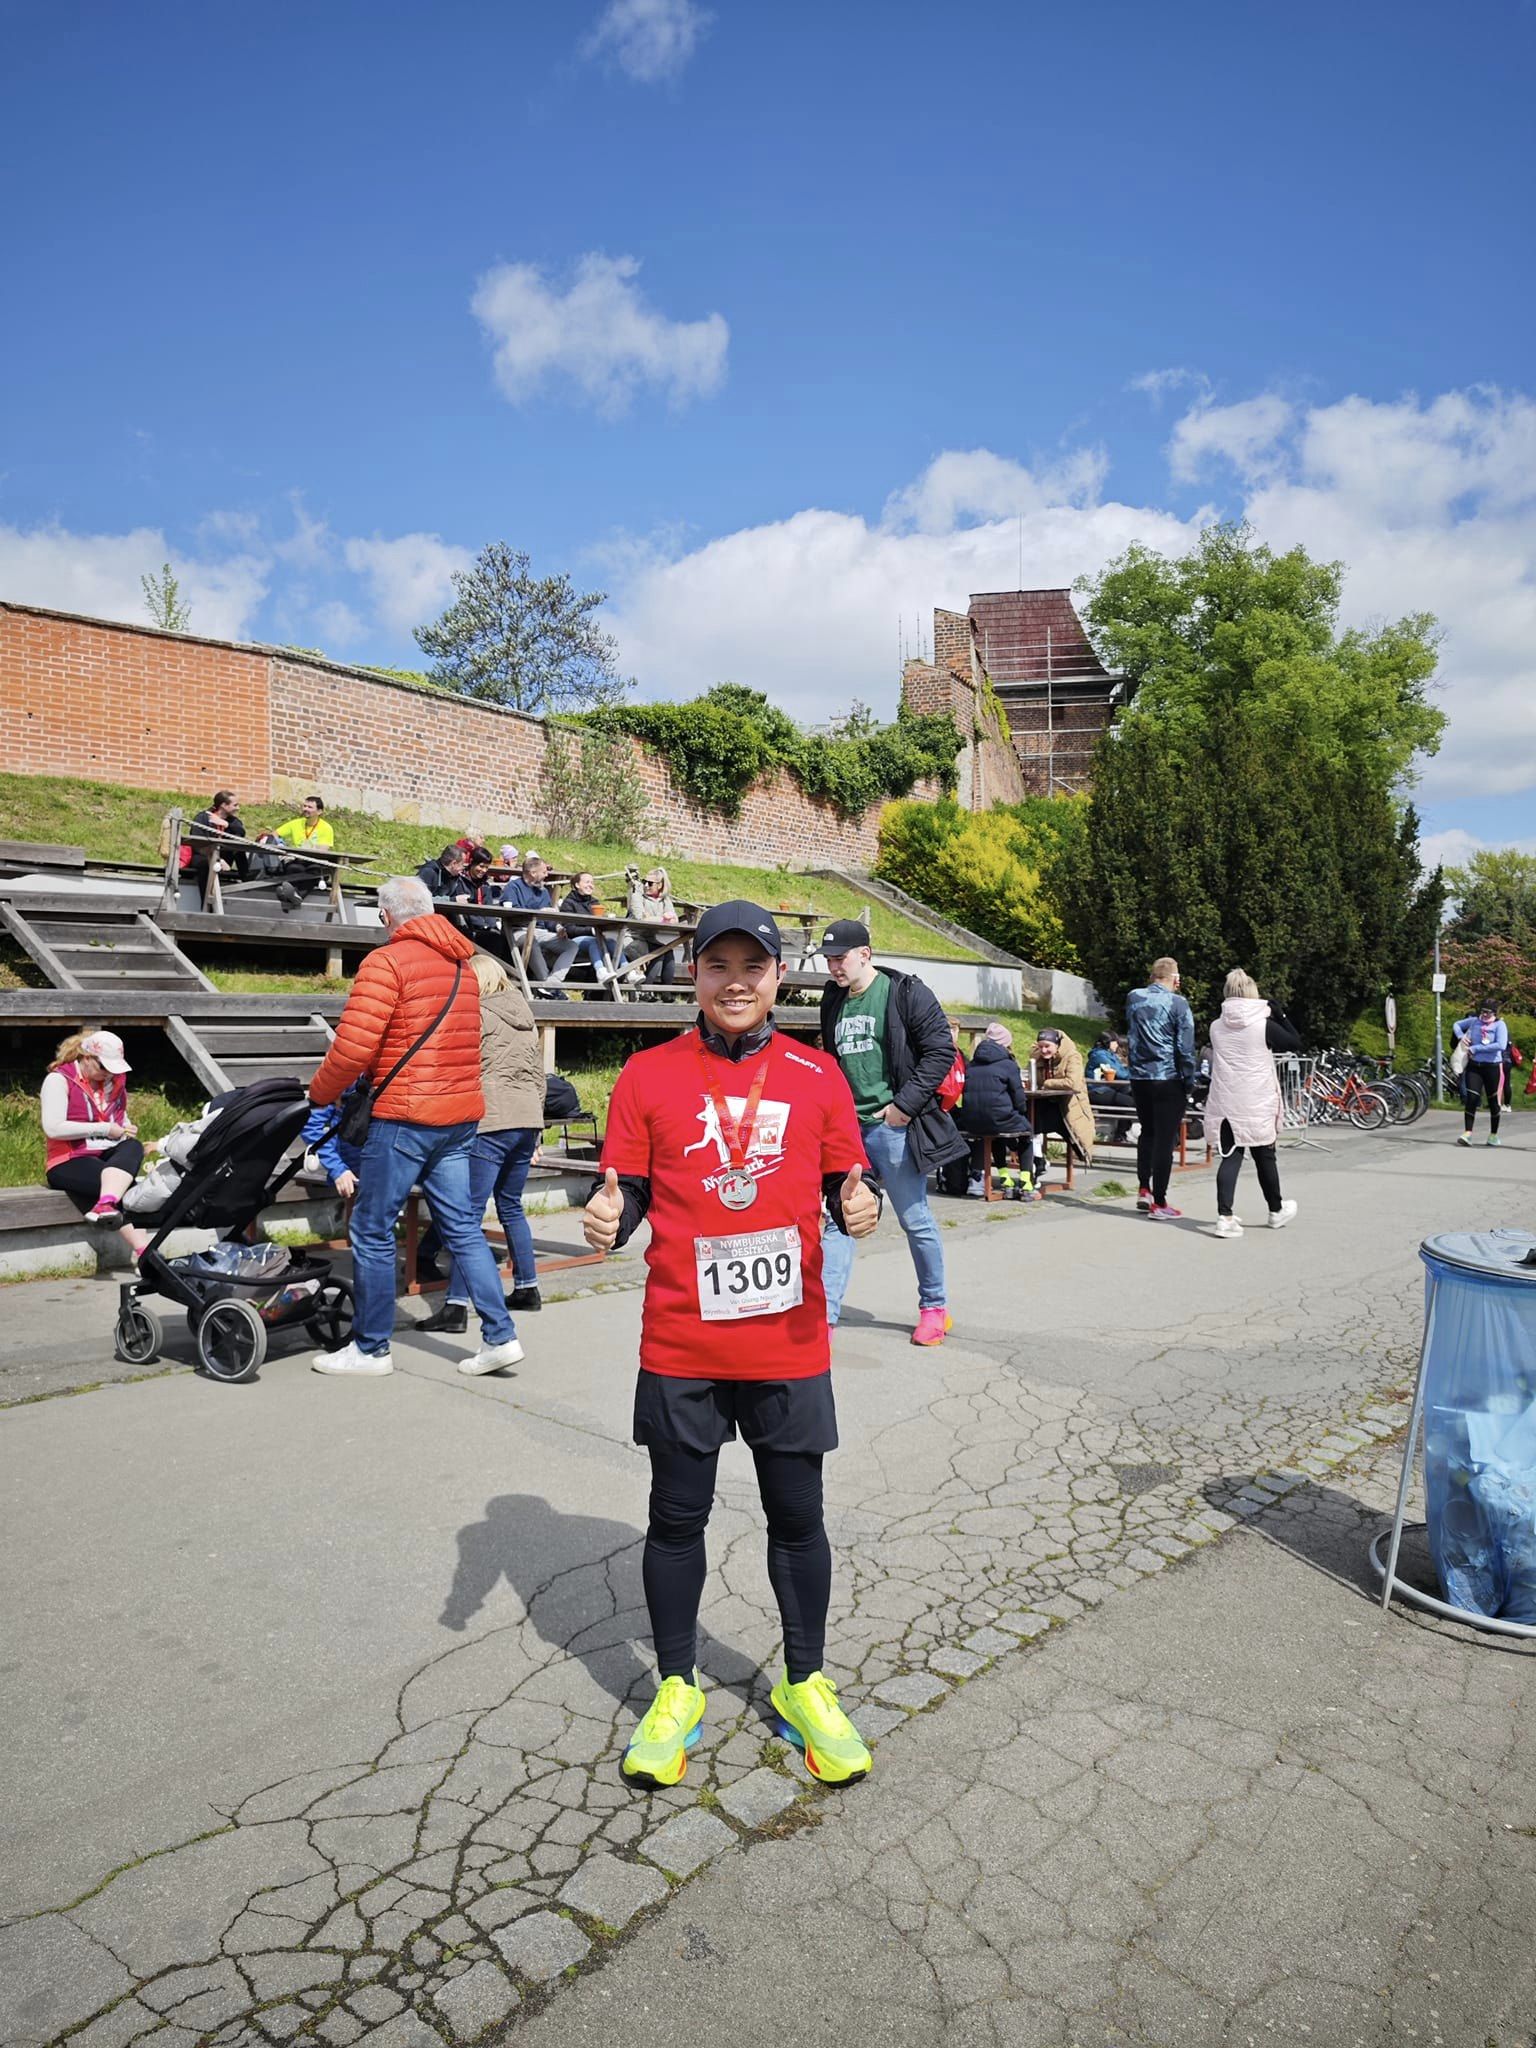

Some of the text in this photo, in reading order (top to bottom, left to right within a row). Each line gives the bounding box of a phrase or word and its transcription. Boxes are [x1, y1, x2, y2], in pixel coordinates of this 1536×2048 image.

[784, 1051, 817, 1069] CRAFT
[720, 1231, 778, 1249] NYMBURSKÁ
[731, 1244, 770, 1258] DESÍTKA
[704, 1253, 791, 1296] 1309
